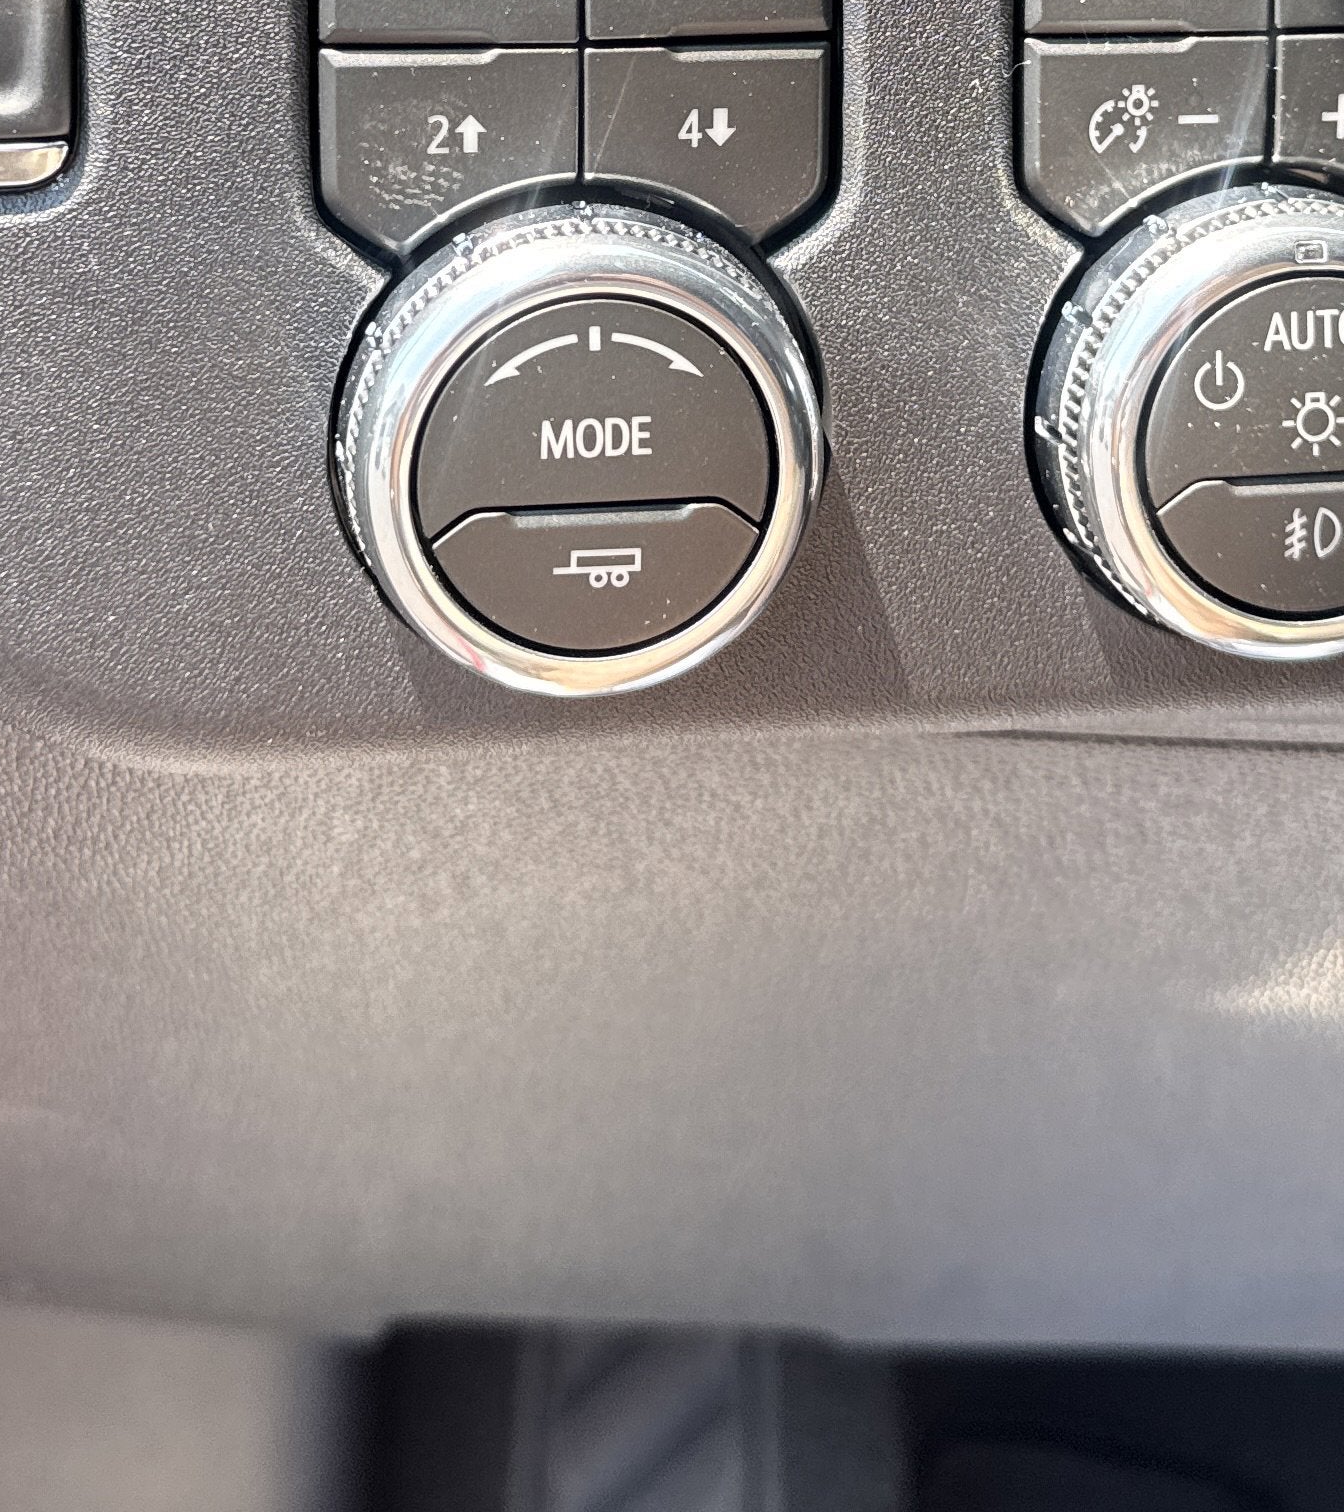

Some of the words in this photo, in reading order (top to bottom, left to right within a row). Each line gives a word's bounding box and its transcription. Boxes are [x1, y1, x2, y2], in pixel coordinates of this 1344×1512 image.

[426, 114, 451, 156] 2
[677, 108, 703, 148] 4
[540, 415, 653, 460] MODE
